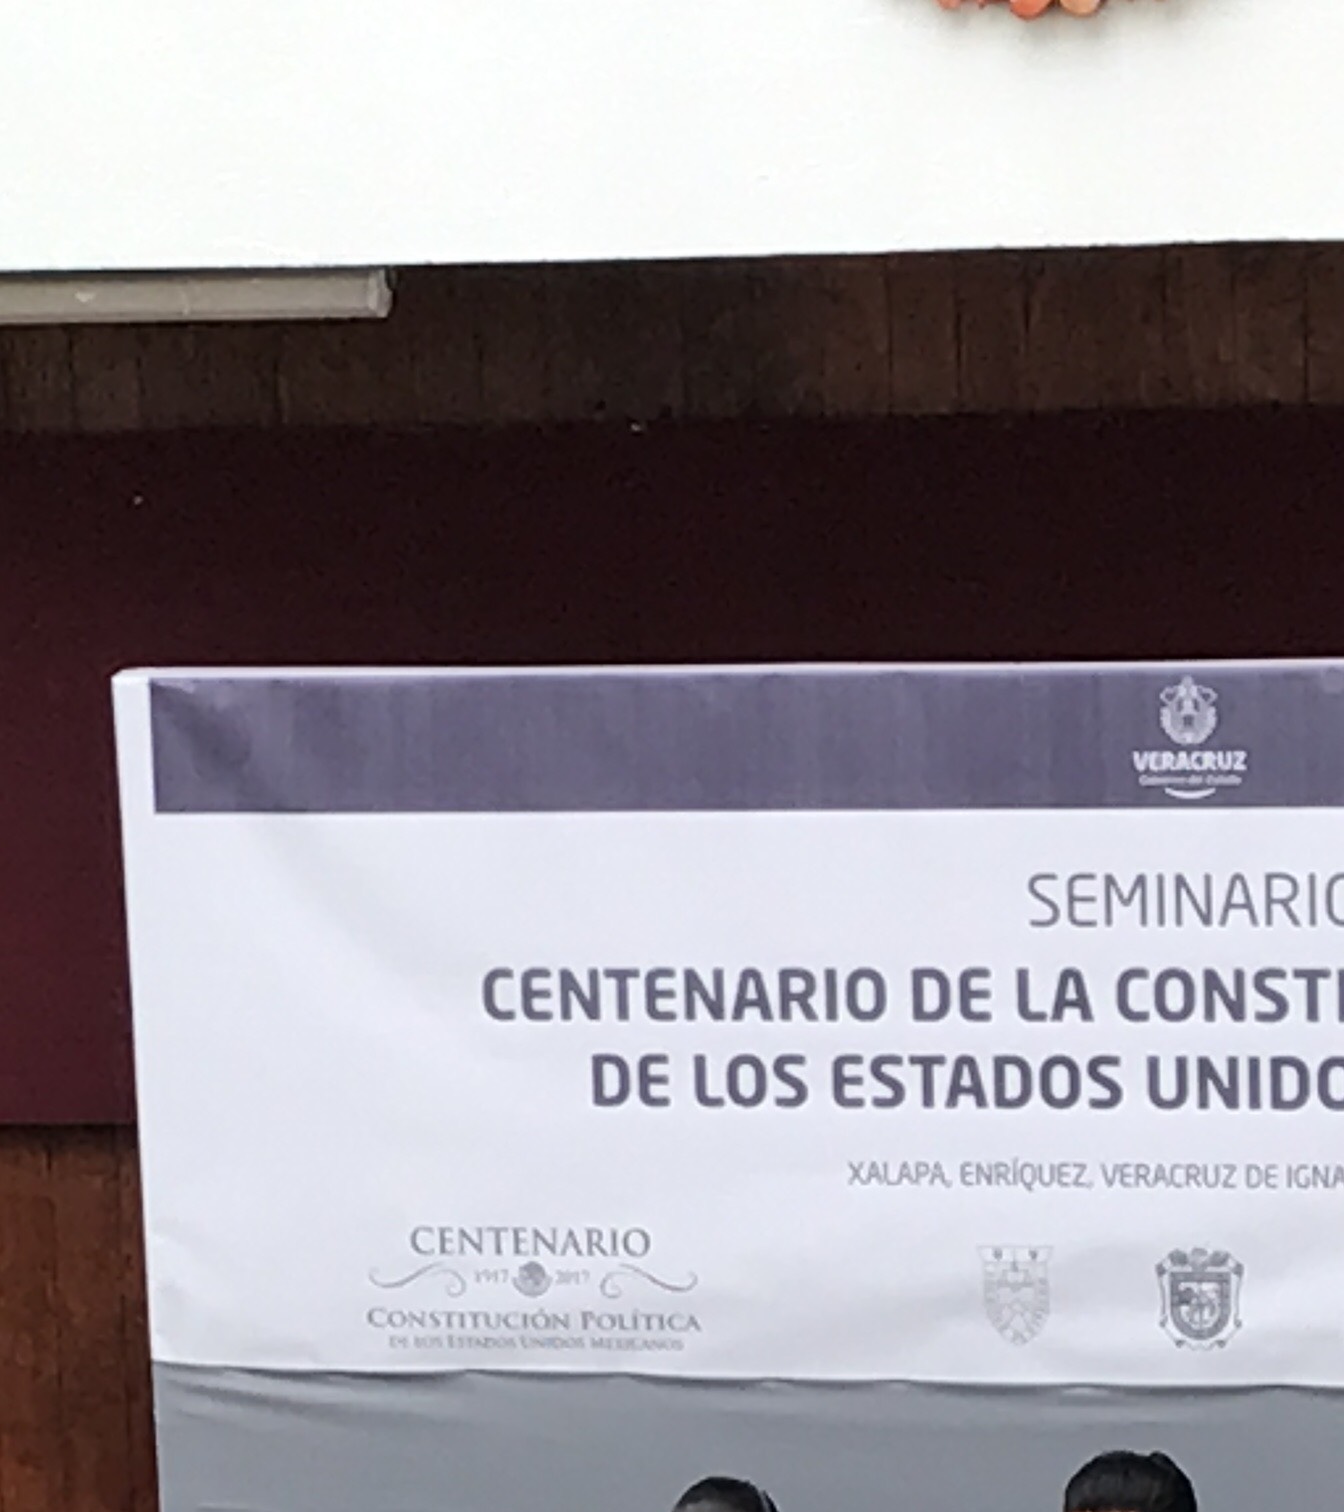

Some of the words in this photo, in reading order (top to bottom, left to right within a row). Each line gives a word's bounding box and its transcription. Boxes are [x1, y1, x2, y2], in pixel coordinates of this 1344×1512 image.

[1132, 751, 1248, 772] VERACRUZ
[482, 967, 887, 1022] CENTENARIO
[910, 967, 992, 1022] DE
[1016, 967, 1095, 1022] LA
[591, 1053, 671, 1108] DE
[693, 1053, 809, 1108] LOS
[831, 1054, 1123, 1110] ESTADOS
[847, 1161, 953, 1189] XALAPA,
[959, 1157, 1095, 1193] ENRÍQUEZ,
[1100, 1163, 1238, 1189] VERACRUZ
[1245, 1164, 1278, 1189] DE
[409, 1226, 652, 1258] CENTENARIO
[473, 1269, 510, 1285] 1917
[554, 1269, 591, 1286] 2017
